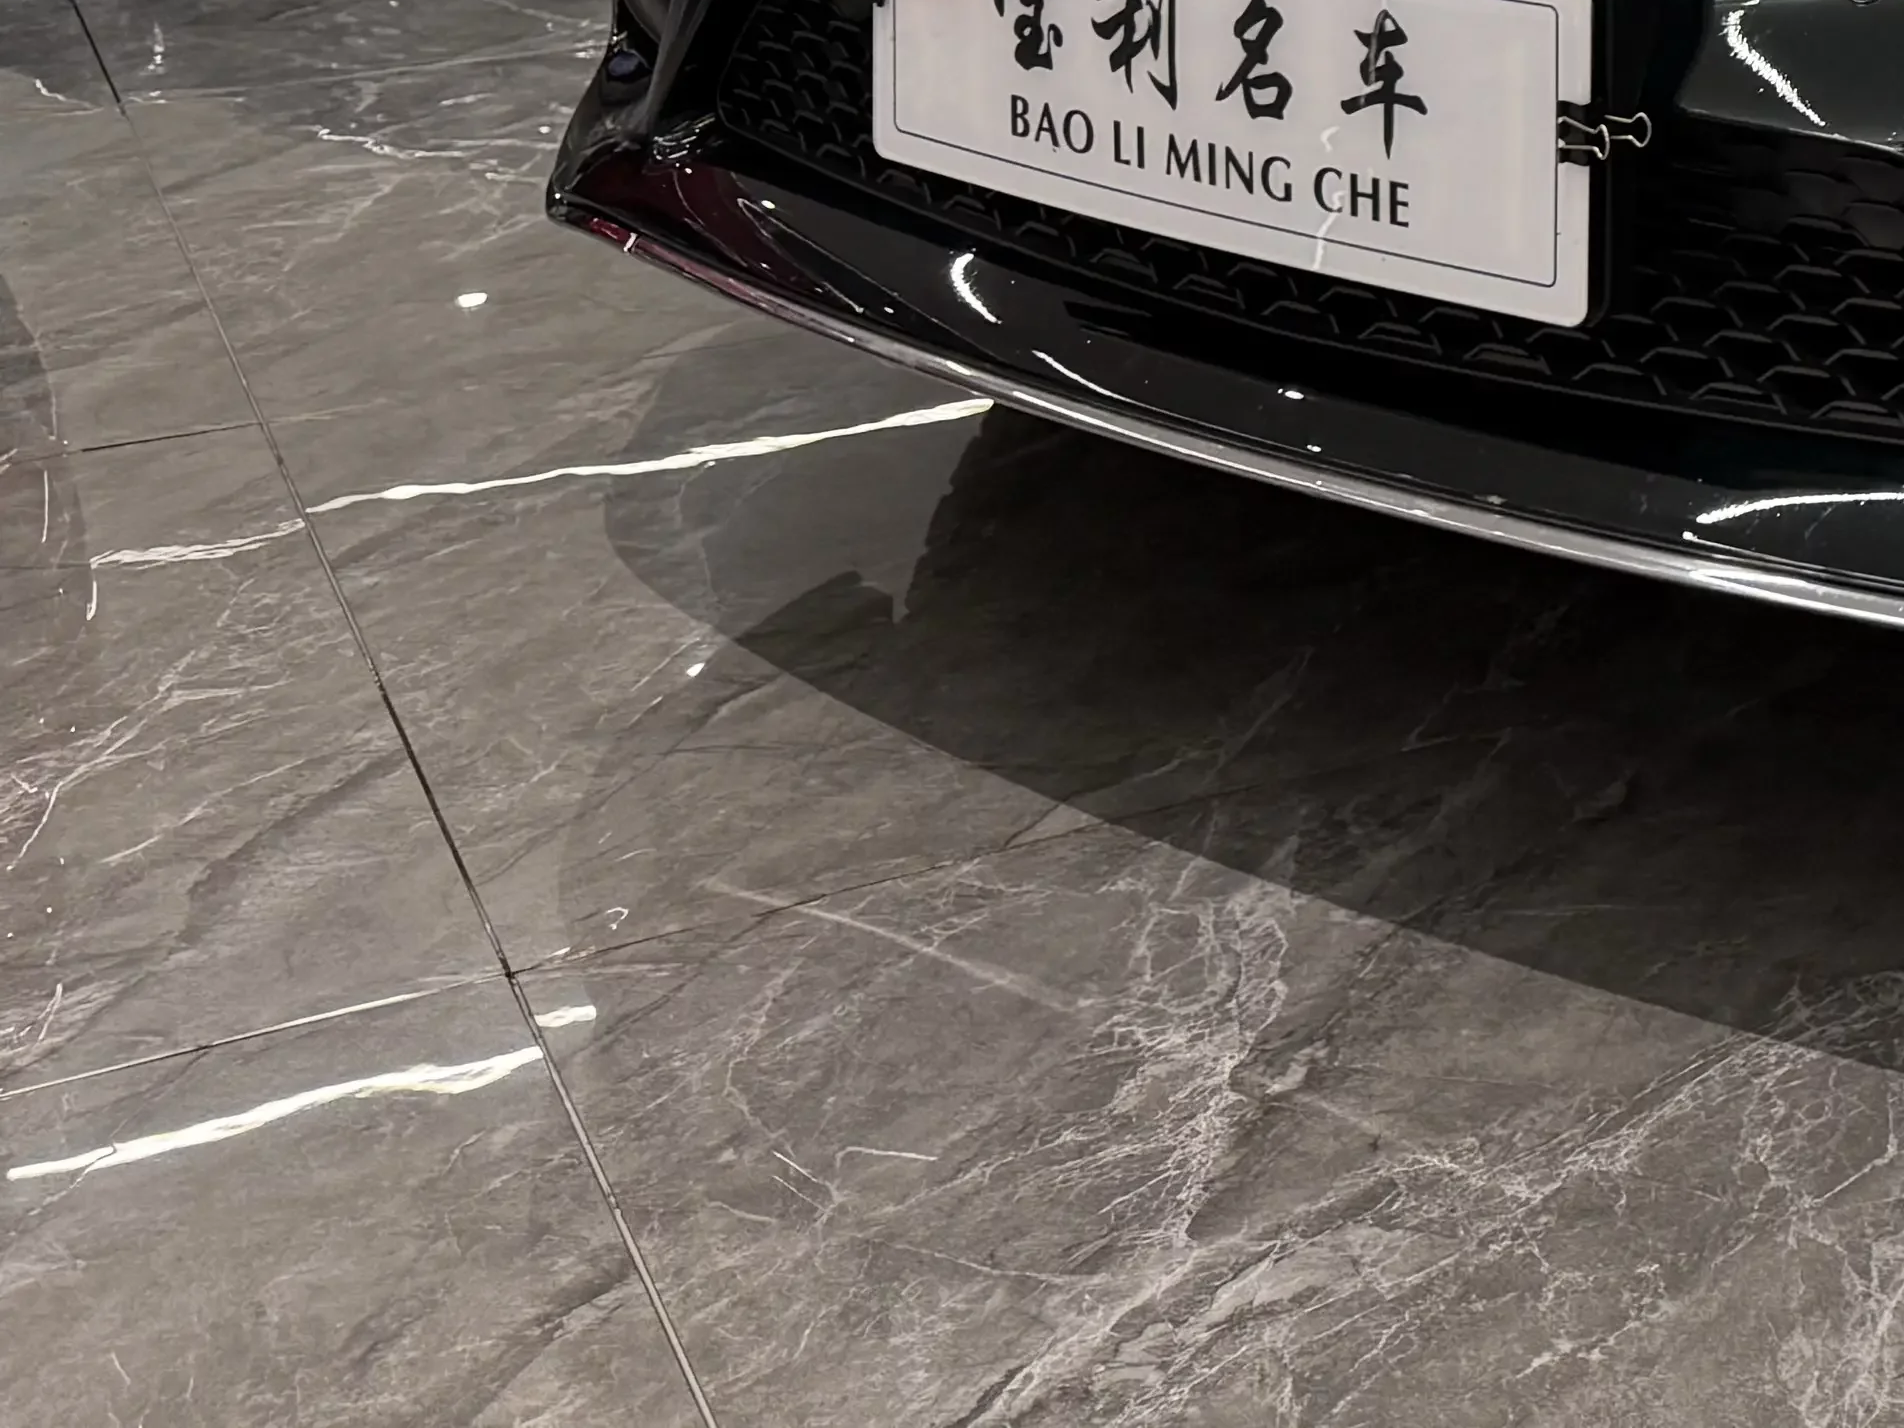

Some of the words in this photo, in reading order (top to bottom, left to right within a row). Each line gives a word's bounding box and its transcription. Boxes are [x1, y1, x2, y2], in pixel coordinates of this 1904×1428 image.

[1010, 94, 1094, 154] BAO
[1113, 120, 1145, 169] LI
[1166, 133, 1293, 202] MING
[1313, 166, 1410, 227] CHE
